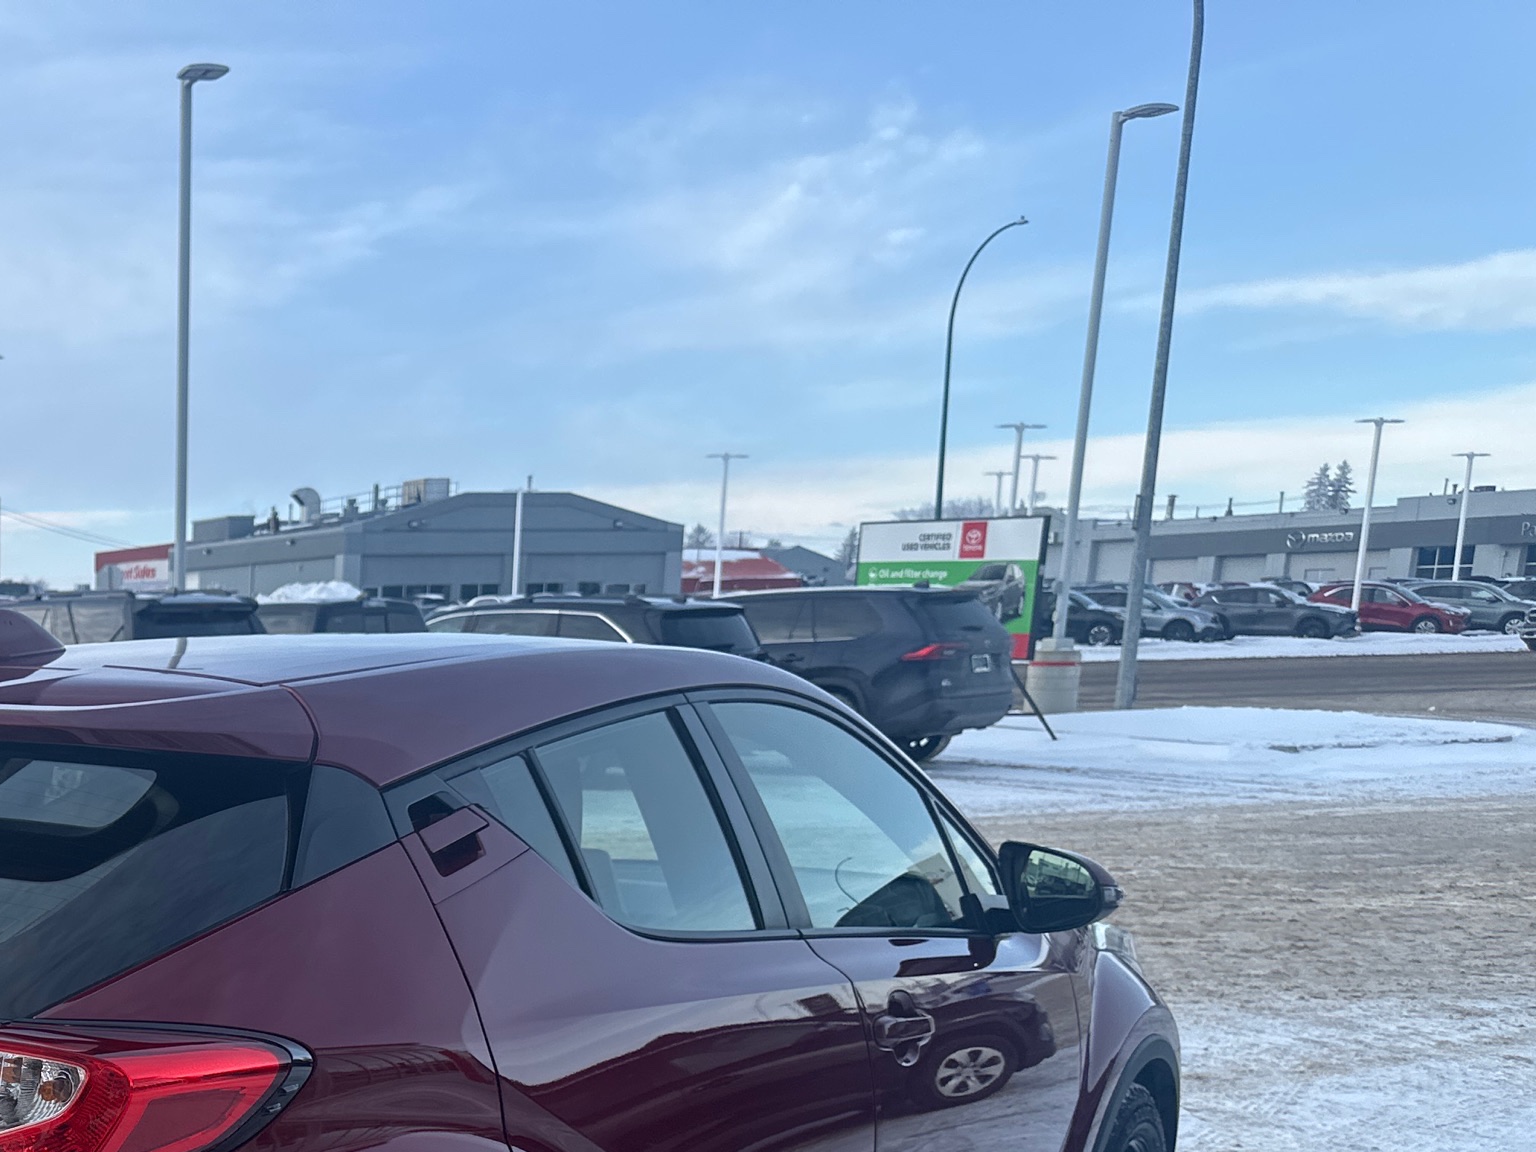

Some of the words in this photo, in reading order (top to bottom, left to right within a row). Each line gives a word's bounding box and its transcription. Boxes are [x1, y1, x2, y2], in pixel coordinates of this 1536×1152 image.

[918, 532, 953, 542] CERTIFIED
[901, 542, 919, 552] USED
[920, 542, 952, 551] VEHICLES
[878, 568, 890, 578] Oil
[890, 568, 904, 579] and
[921, 569, 948, 581] change
